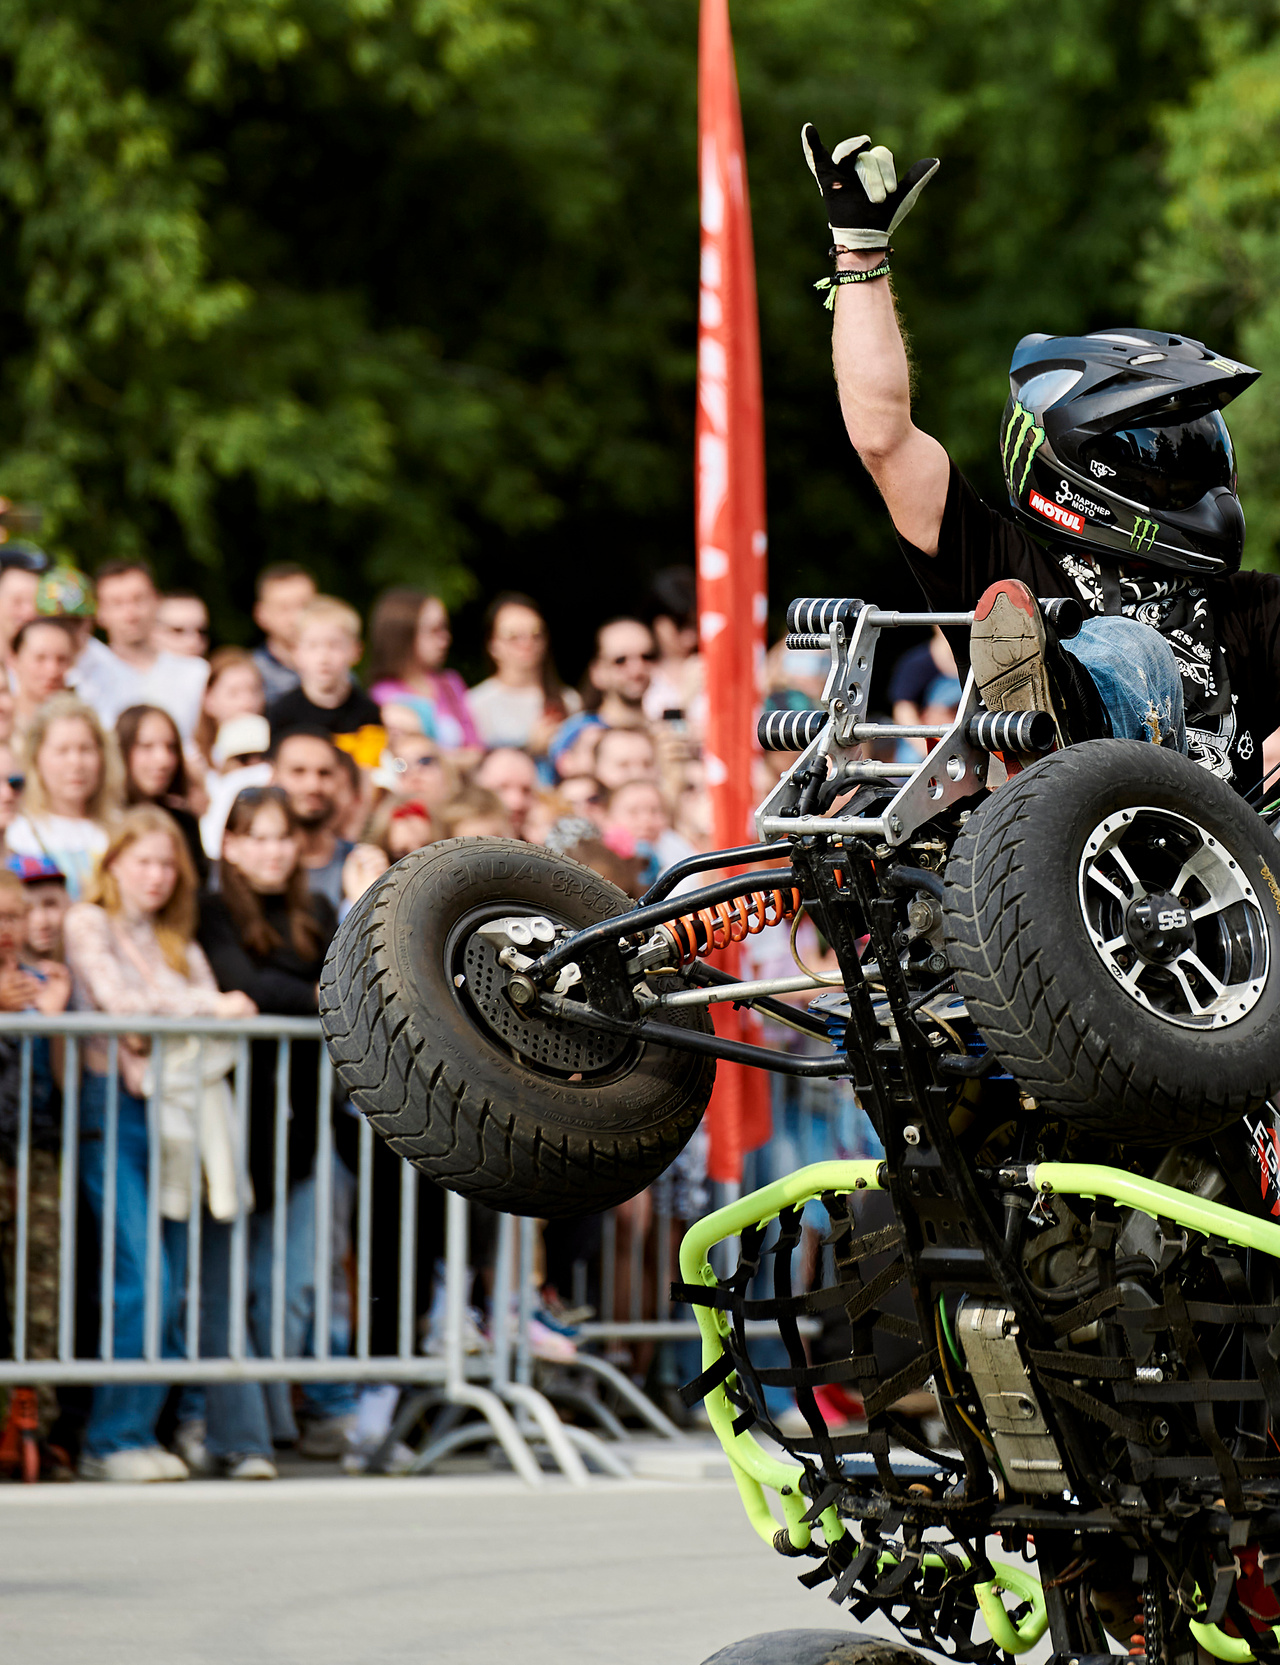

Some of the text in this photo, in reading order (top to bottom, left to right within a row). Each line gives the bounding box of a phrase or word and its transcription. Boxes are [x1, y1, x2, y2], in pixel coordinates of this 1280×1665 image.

[1031, 494, 1081, 531] MOTUL
[1074, 493, 1111, 516] ПАРТНЕР
[428, 860, 542, 903] KENDA
[1157, 908, 1188, 931] SS
[1250, 1144, 1278, 1191] STUNT
